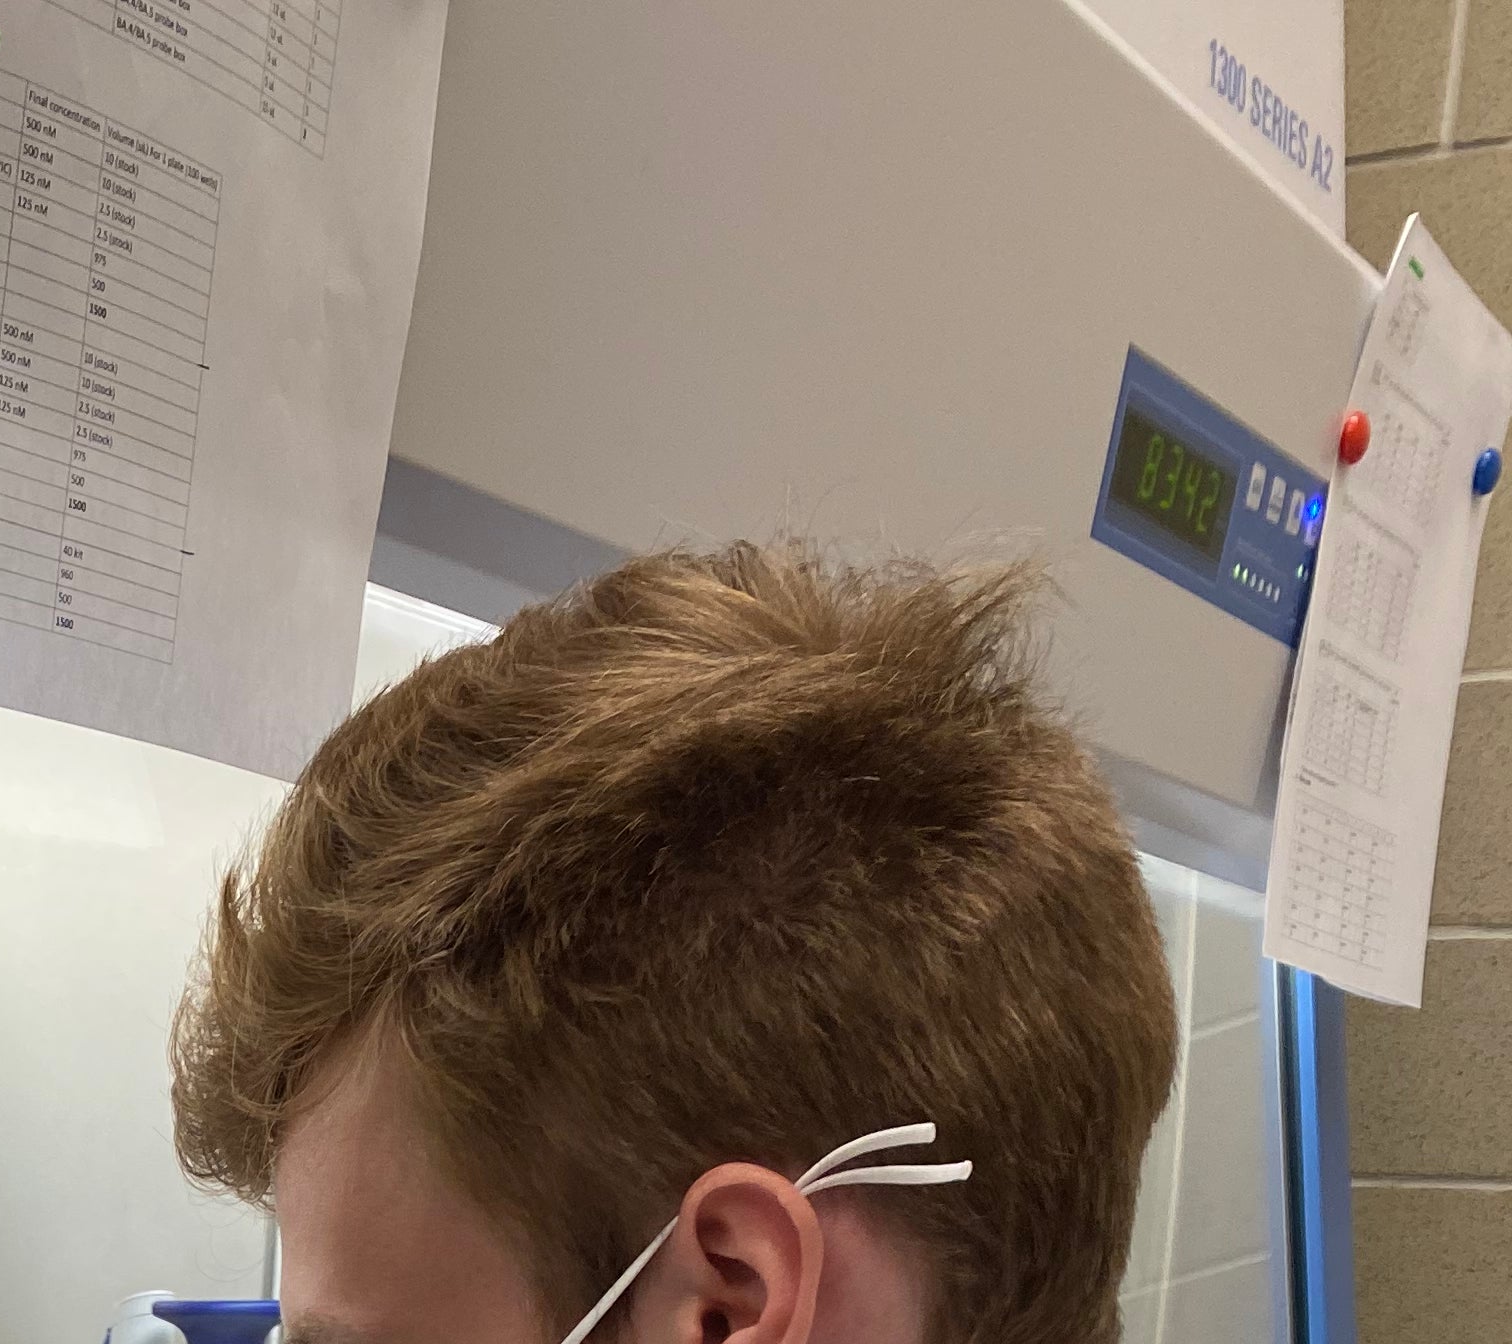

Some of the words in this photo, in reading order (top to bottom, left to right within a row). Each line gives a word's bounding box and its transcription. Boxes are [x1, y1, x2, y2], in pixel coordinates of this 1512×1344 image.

[28, 90, 48, 109] Final
[49, 102, 101, 132] concentration
[1208, 38, 1247, 113] 1300
[1249, 75, 1308, 170] SERIES
[1311, 133, 1334, 192] A2
[20, 168, 36, 185] 125
[17, 195, 33, 212] 125
[89, 302, 107, 319] 1500
[73, 449, 87, 462] 975
[71, 474, 85, 488] 500
[68, 498, 87, 512] 1500
[58, 592, 73, 606] 500
[56, 616, 74, 630] 1500
